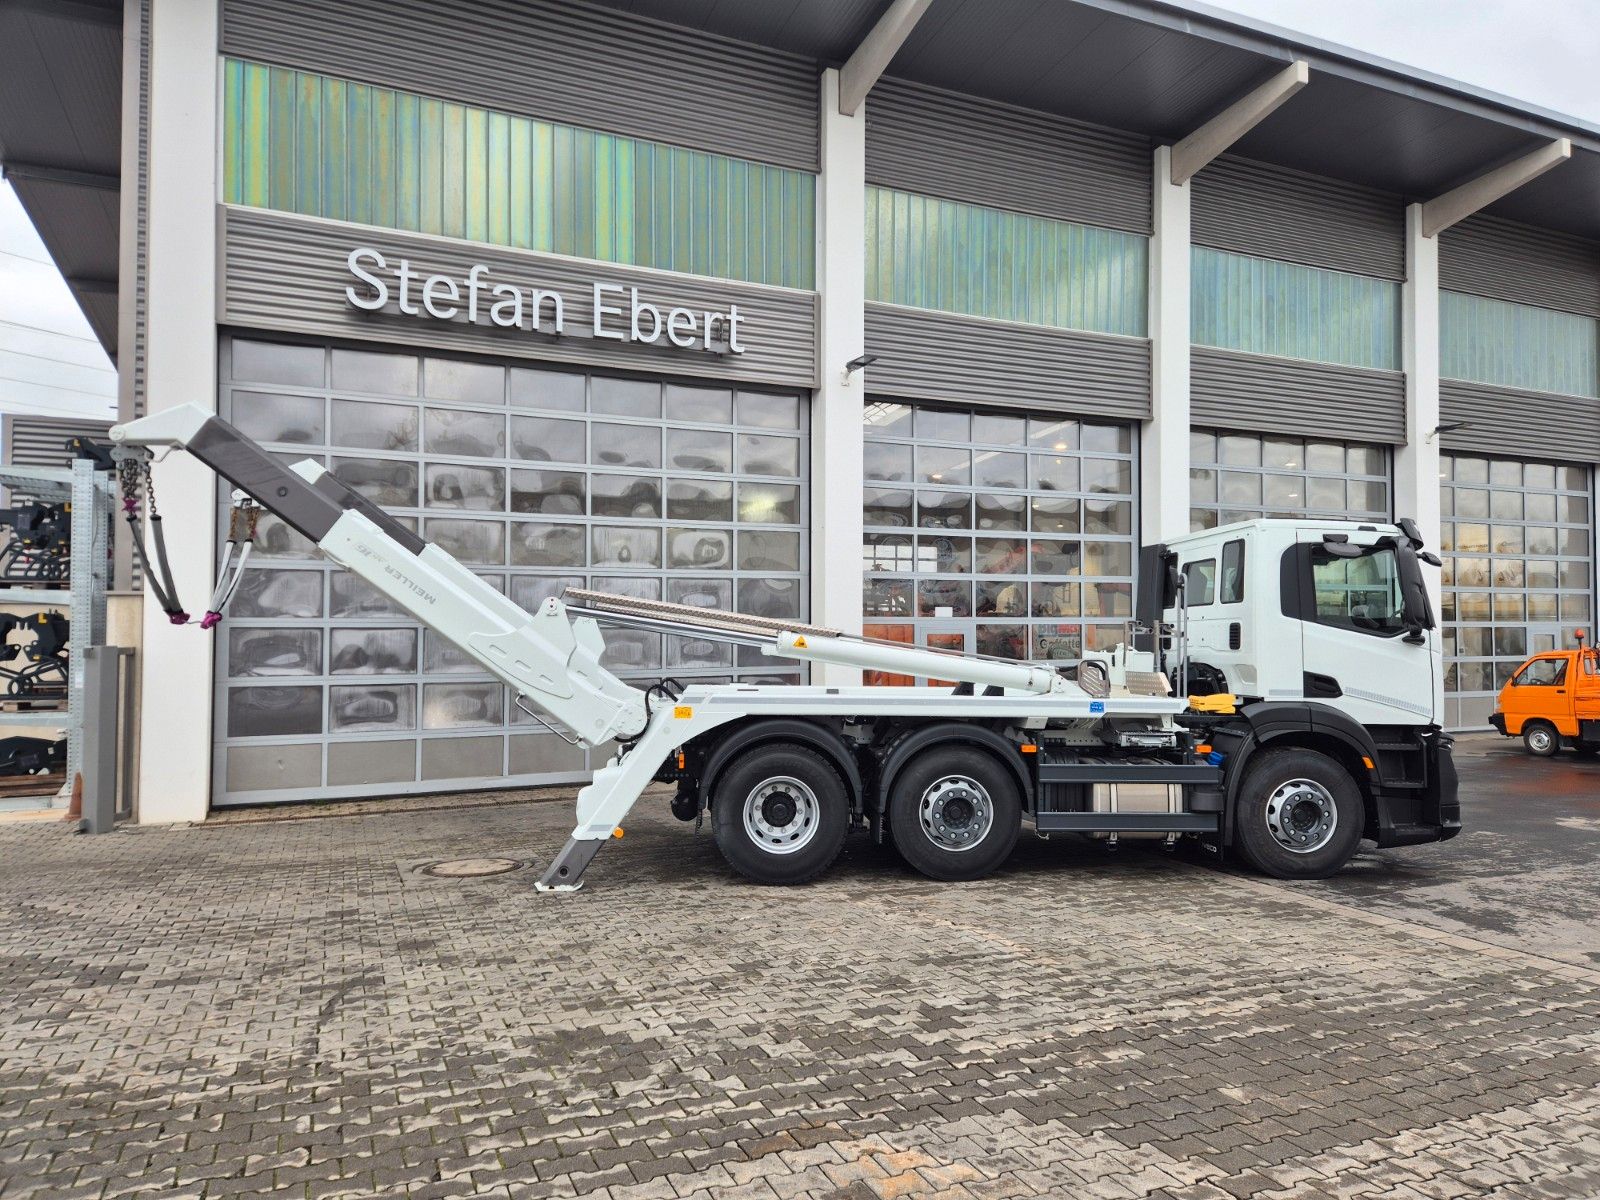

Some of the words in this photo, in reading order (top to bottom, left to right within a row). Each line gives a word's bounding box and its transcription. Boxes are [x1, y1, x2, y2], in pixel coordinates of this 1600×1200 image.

[345, 248, 565, 334] Stefan
[593, 283, 745, 353] Ebert
[385, 565, 437, 605] MEILLER
